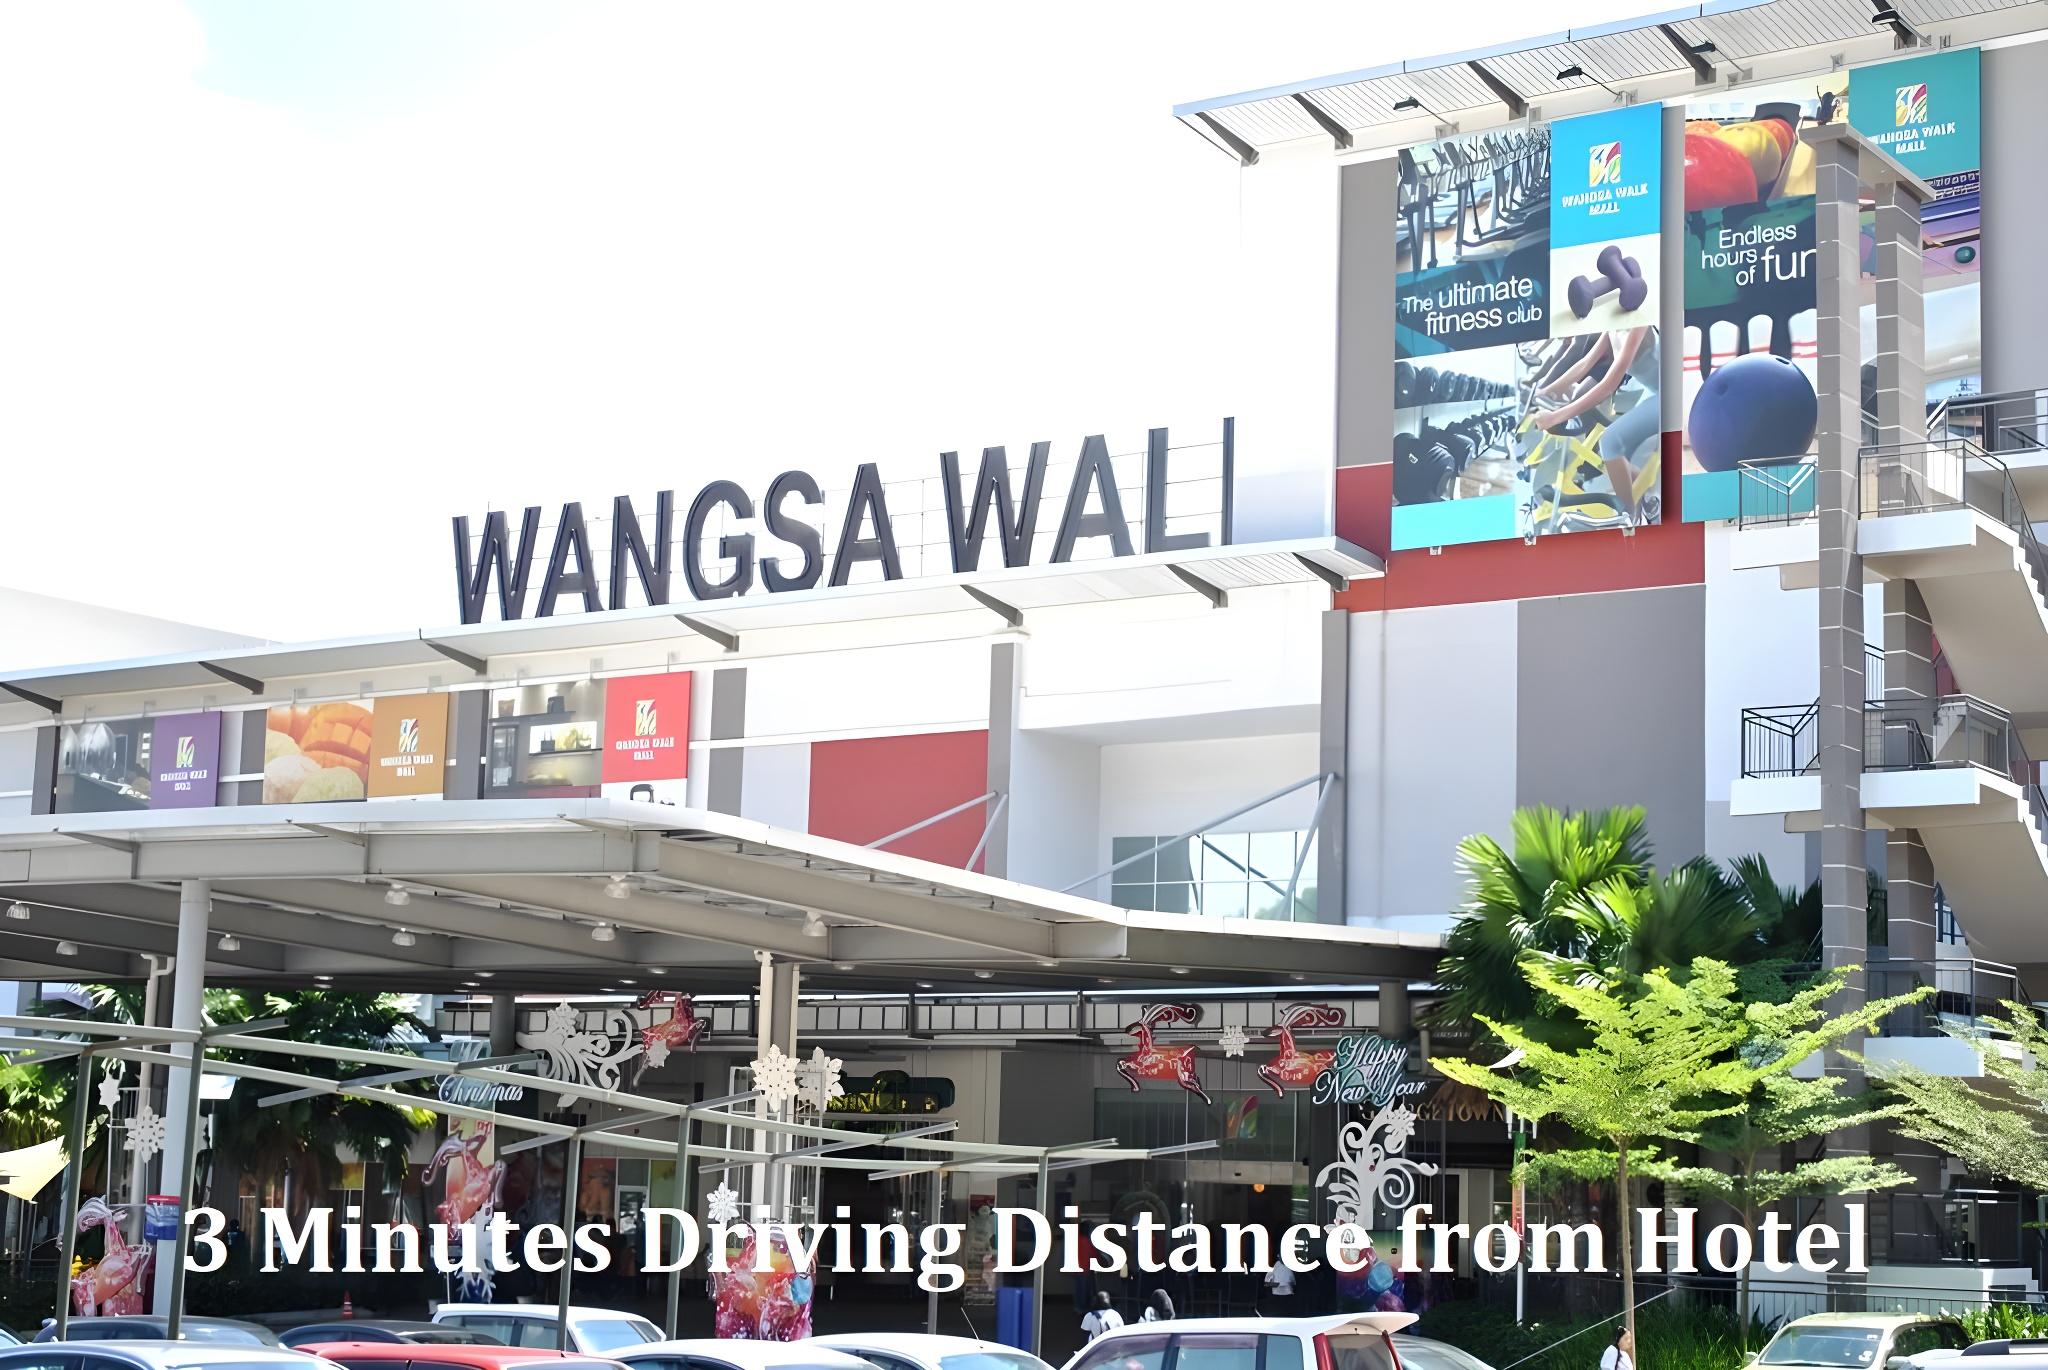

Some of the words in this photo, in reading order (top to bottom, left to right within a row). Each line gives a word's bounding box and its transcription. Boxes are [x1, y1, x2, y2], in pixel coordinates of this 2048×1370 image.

[1922, 121, 1956, 138] WALK
[1895, 140, 1927, 154] MALL
[1615, 182, 1649, 198] WALK
[1719, 224, 1797, 249] Endless
[1701, 248, 1758, 270] hours
[1735, 264, 1757, 286] of
[1402, 295, 1434, 314] The
[1438, 275, 1534, 309] ultimate
[1424, 307, 1503, 337] fitness
[1506, 303, 1543, 325] club
[452, 462, 904, 625] WANGSA
[1333, 1034, 1409, 1084] Happy
[1312, 1065, 1366, 1105] New
[1373, 1071, 1428, 1107] Year
